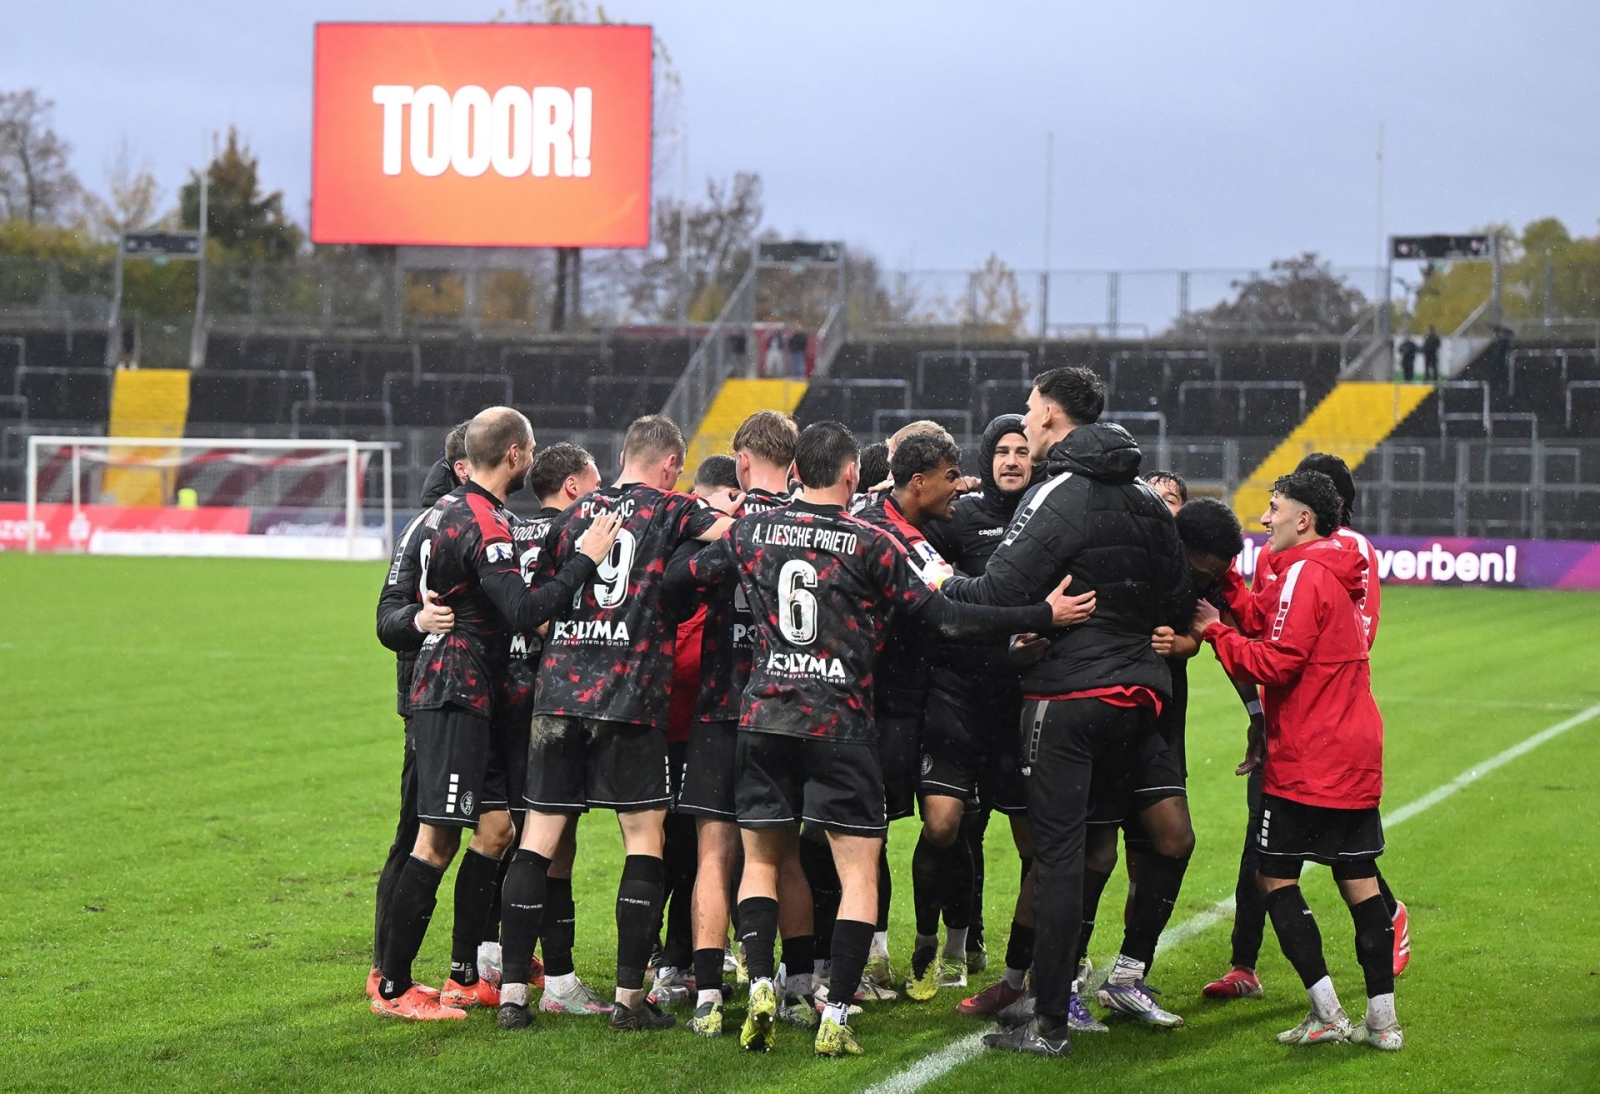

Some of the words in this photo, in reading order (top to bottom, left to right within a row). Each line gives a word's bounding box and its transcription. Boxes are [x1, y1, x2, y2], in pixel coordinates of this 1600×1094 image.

[373, 84, 593, 178] TOOOR!
[752, 522, 763, 544] A.
[764, 523, 813, 548] LIESCHE
[813, 528, 858, 555] PRIETO
[553, 619, 630, 641] POLYMA
[777, 559, 818, 646] 6
